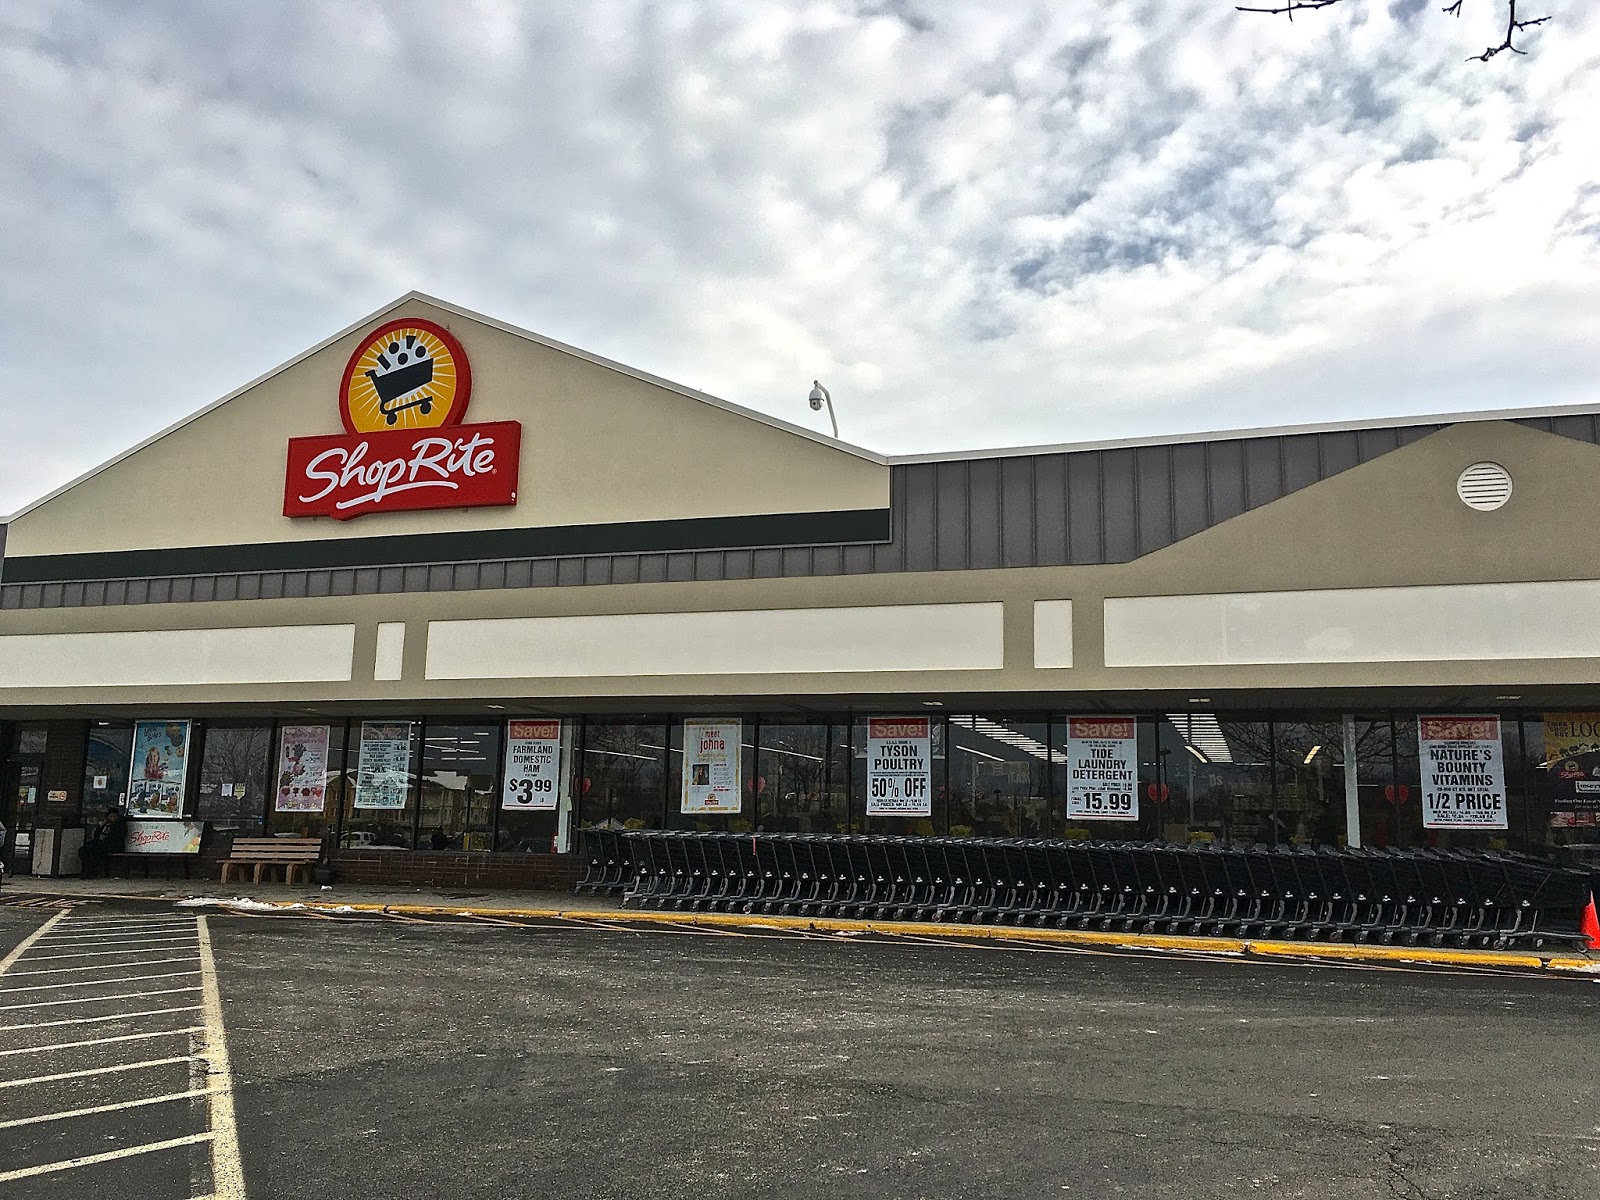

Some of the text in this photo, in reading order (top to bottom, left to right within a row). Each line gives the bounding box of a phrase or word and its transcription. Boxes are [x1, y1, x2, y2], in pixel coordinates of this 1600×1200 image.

[299, 432, 495, 503] ShopRite
[513, 722, 554, 738] Save!
[704, 730, 720, 738] meet
[874, 720, 923, 737] Save!
[1075, 720, 1128, 737] Save!
[1426, 720, 1492, 738] Save!
[512, 745, 553, 754] FARMLAND
[699, 738, 725, 754] johna
[880, 745, 918, 757] TYSON
[513, 755, 552, 764] DOMESTIC
[1090, 748, 1114, 759] TIDE
[1430, 749, 1492, 761] NATURE'S
[523, 764, 540, 773] HAM
[874, 758, 924, 770] POULTRY
[1078, 759, 1127, 770] LAUNDRY
[1437, 762, 1487, 773] BOUNTY
[1072, 769, 1133, 781] DETERGENT
[1431, 774, 1493, 786] VITAMINS
[871, 777, 927, 798] 50% OFF
[1083, 792, 1132, 811] 15.99
[1426, 792, 1502, 810] 1/2 PRICE
[128, 831, 170, 845] ShopRite
